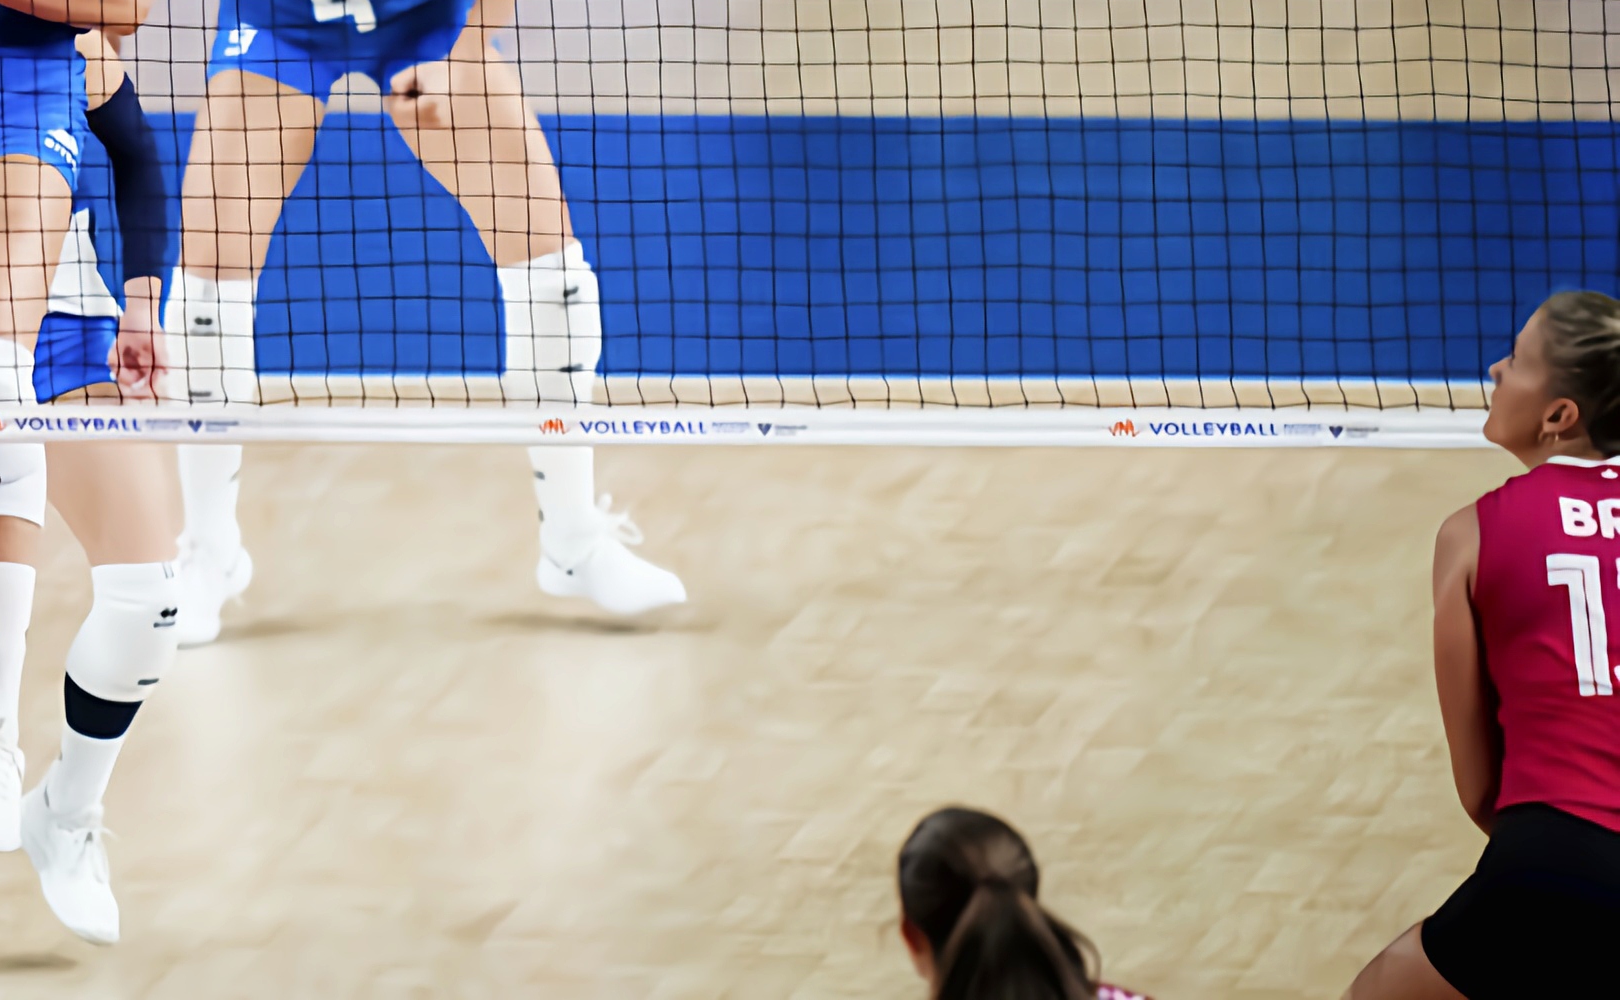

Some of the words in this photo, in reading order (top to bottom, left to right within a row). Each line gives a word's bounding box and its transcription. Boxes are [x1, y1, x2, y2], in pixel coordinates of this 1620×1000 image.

[15, 417, 141, 432] VOLLEYBALL
[579, 420, 707, 435] VOLLEYBALL
[1149, 422, 1278, 436] VOLLEYBALL
[1545, 553, 1620, 697] 1
